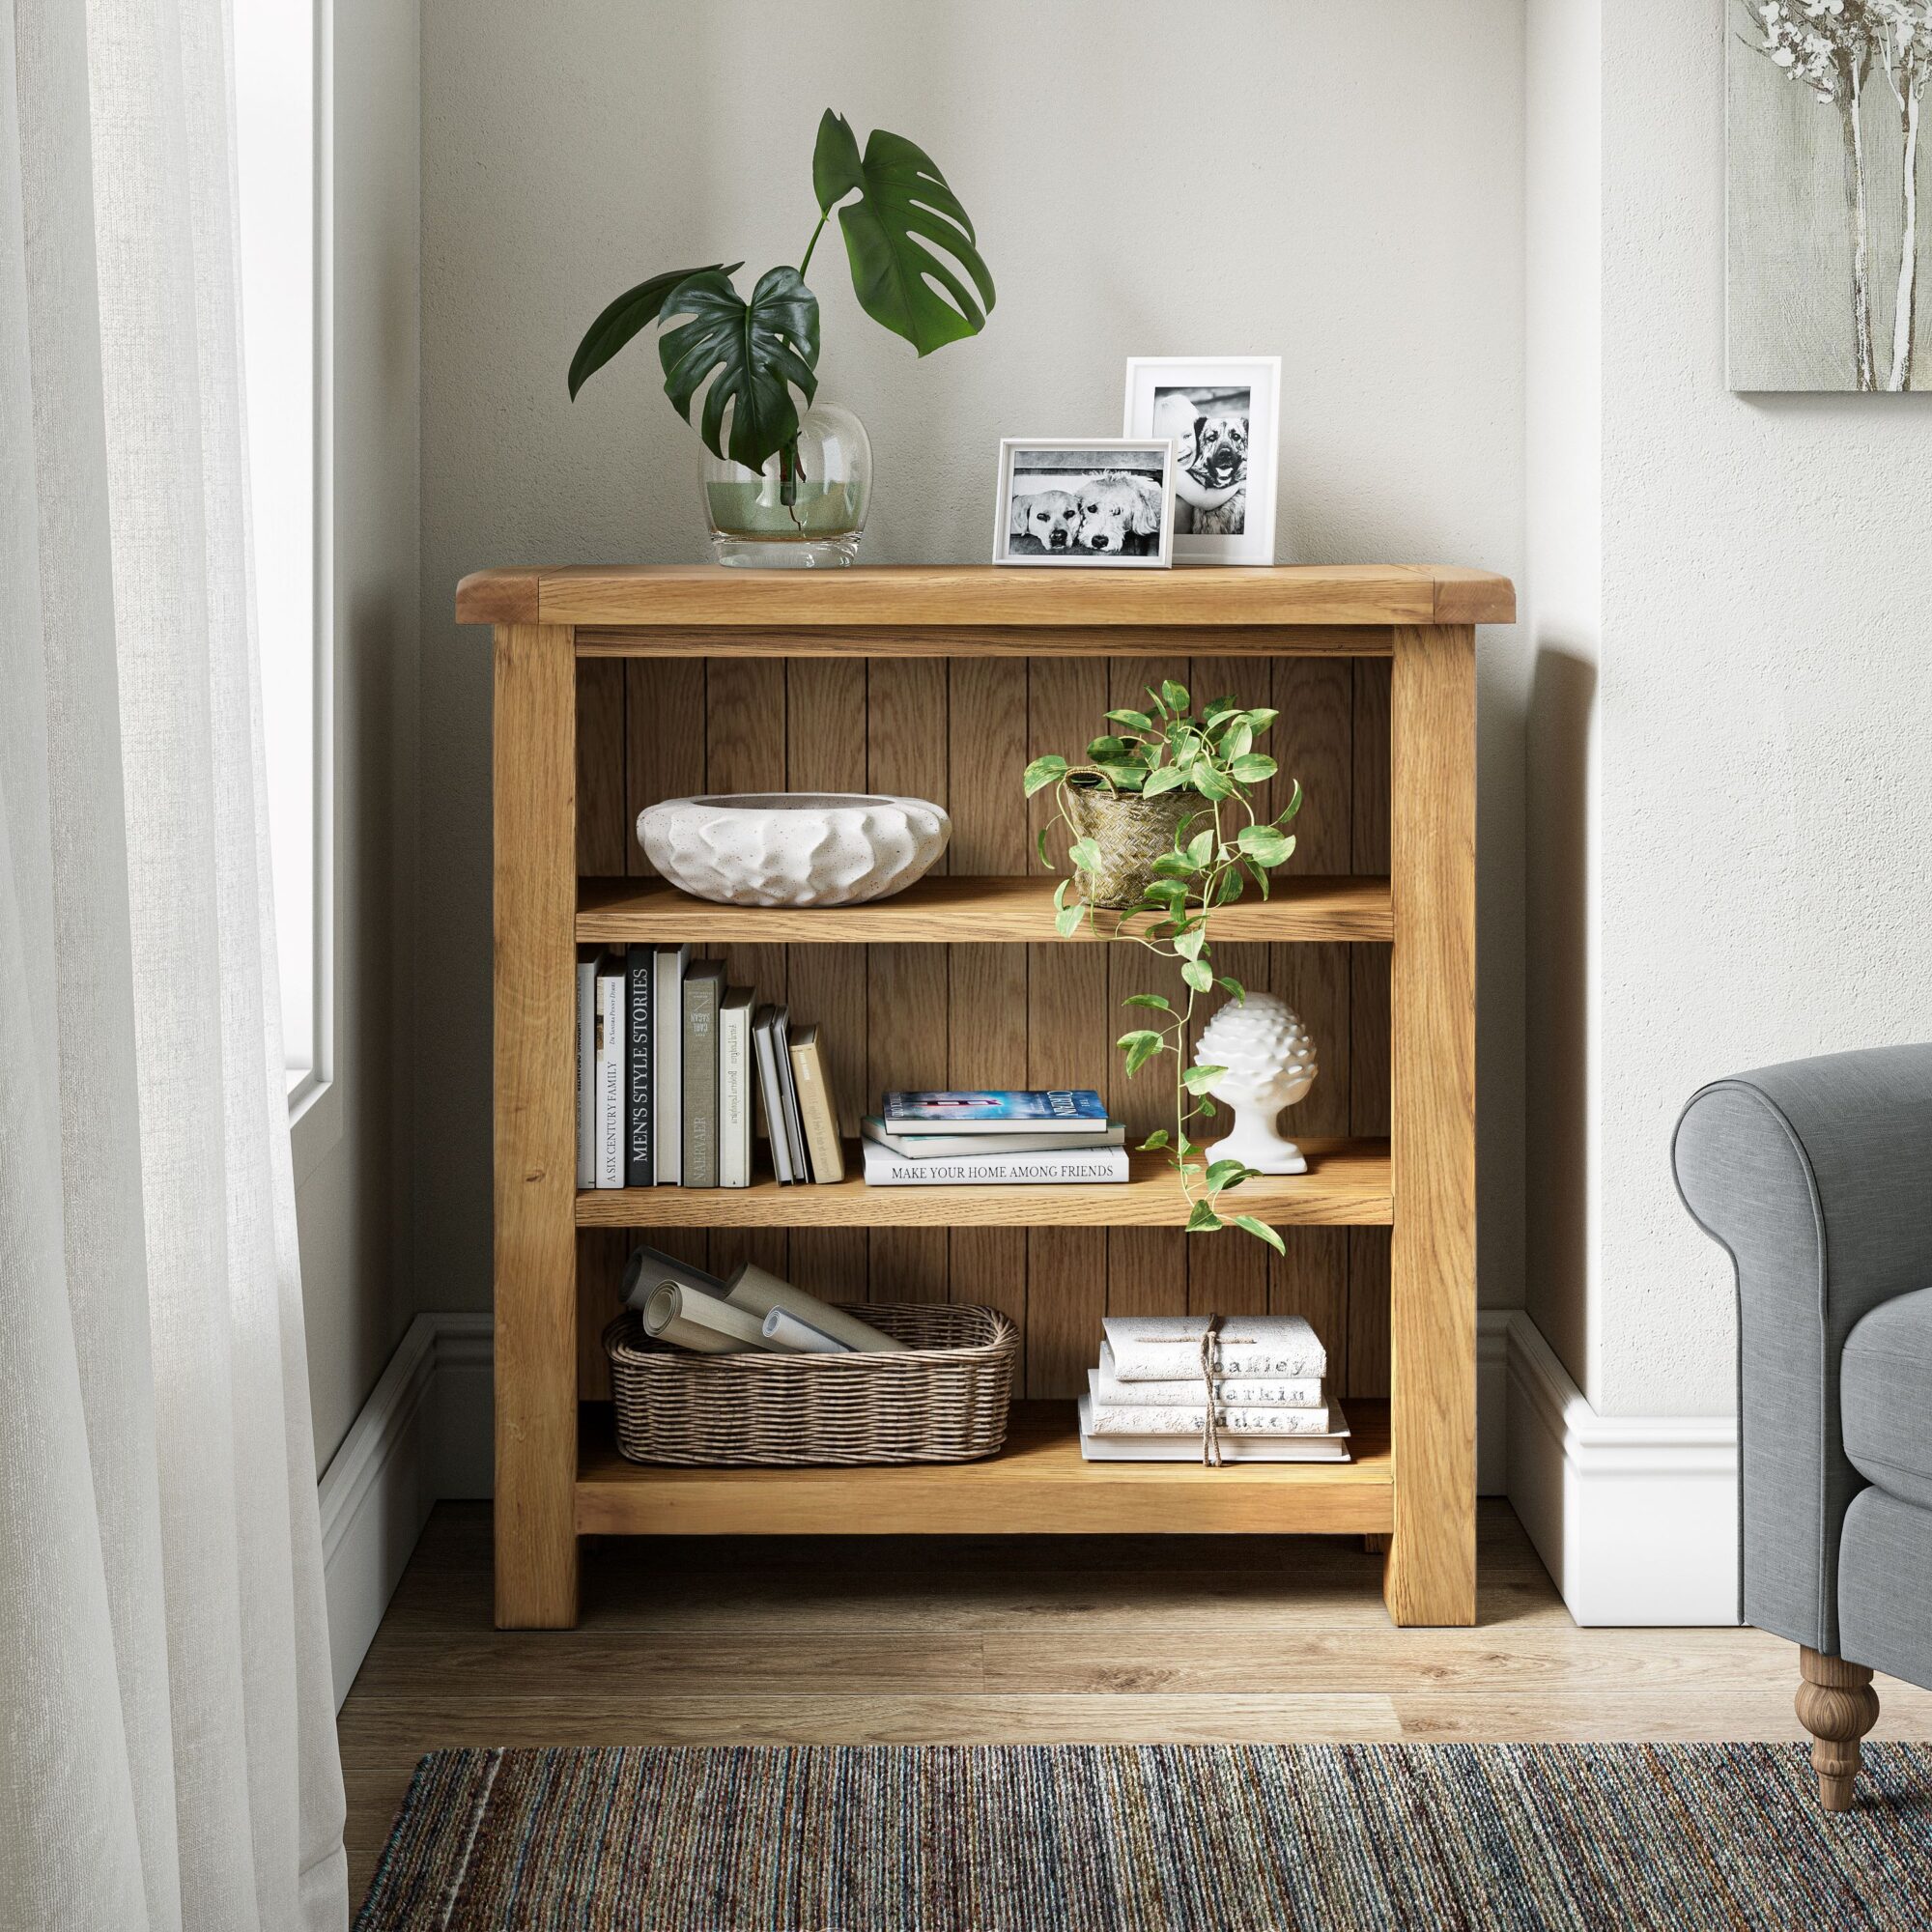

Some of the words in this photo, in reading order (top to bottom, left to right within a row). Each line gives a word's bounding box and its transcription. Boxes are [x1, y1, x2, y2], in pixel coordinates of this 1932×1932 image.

[632, 969, 648, 1042] STORIES
[691, 1012, 710, 1022] SAGAN
[693, 1022, 708, 1032] CARL
[607, 1062, 616, 1101] FAMILY
[632, 1047, 648, 1103] STYLE
[607, 1104, 616, 1154] CENTURY
[632, 1108, 648, 1162] MEN'S
[607, 1156, 616, 1173] SIX
[892, 1167, 927, 1179] MAKE
[930, 1167, 964, 1179] YOUR
[969, 1166, 1007, 1179] HOME
[1010, 1165, 1058, 1178] AMONG
[1062, 1165, 1113, 1178] FRIENDS
